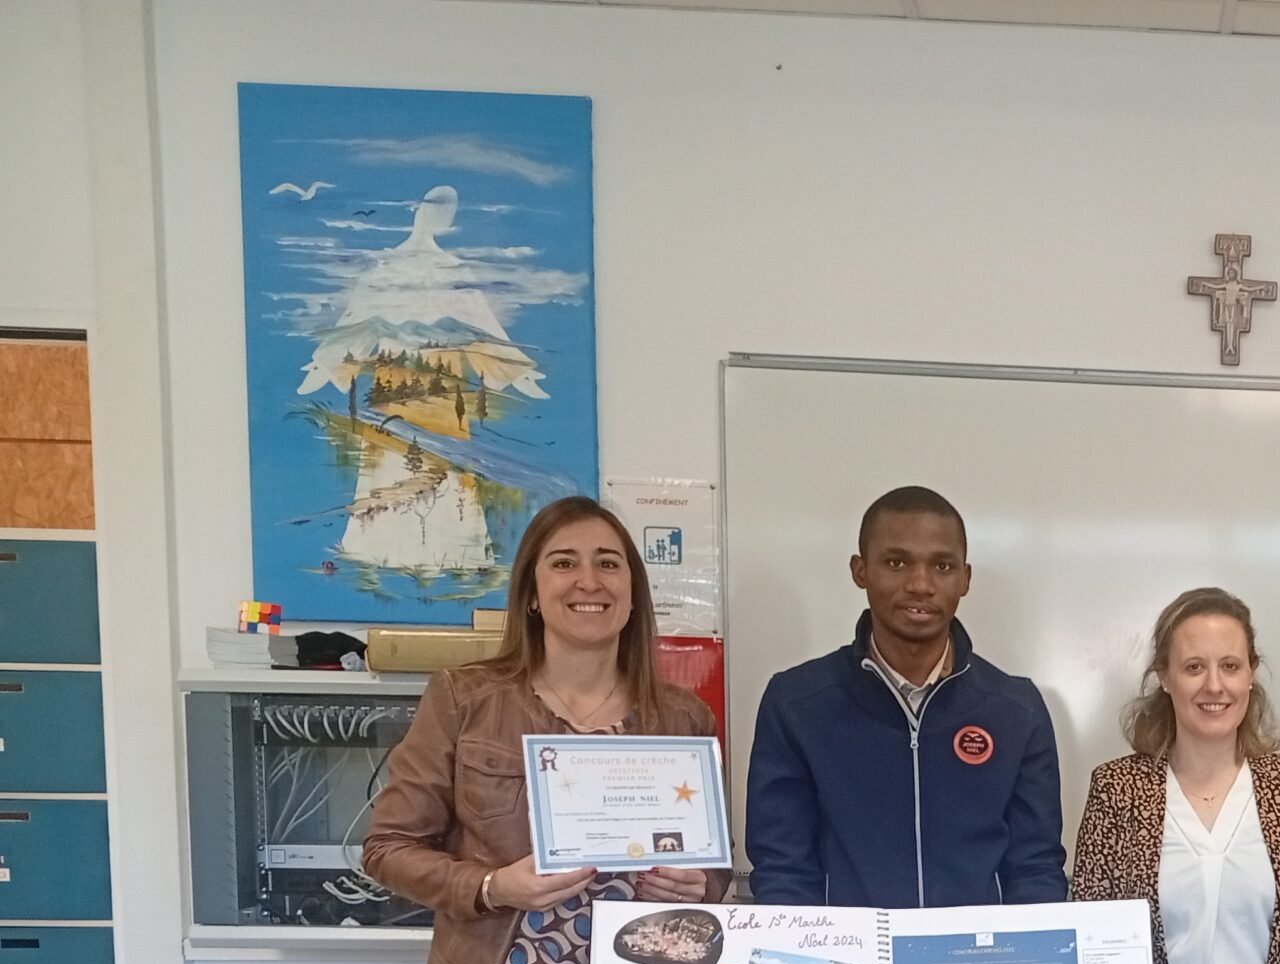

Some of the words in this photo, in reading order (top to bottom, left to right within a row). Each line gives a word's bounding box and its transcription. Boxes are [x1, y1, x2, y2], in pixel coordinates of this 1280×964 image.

[636, 497, 689, 506] CONFINEMENT
[569, 756, 621, 766] Concours
[624, 755, 638, 765] de
[833, 935, 863, 949] 2024
